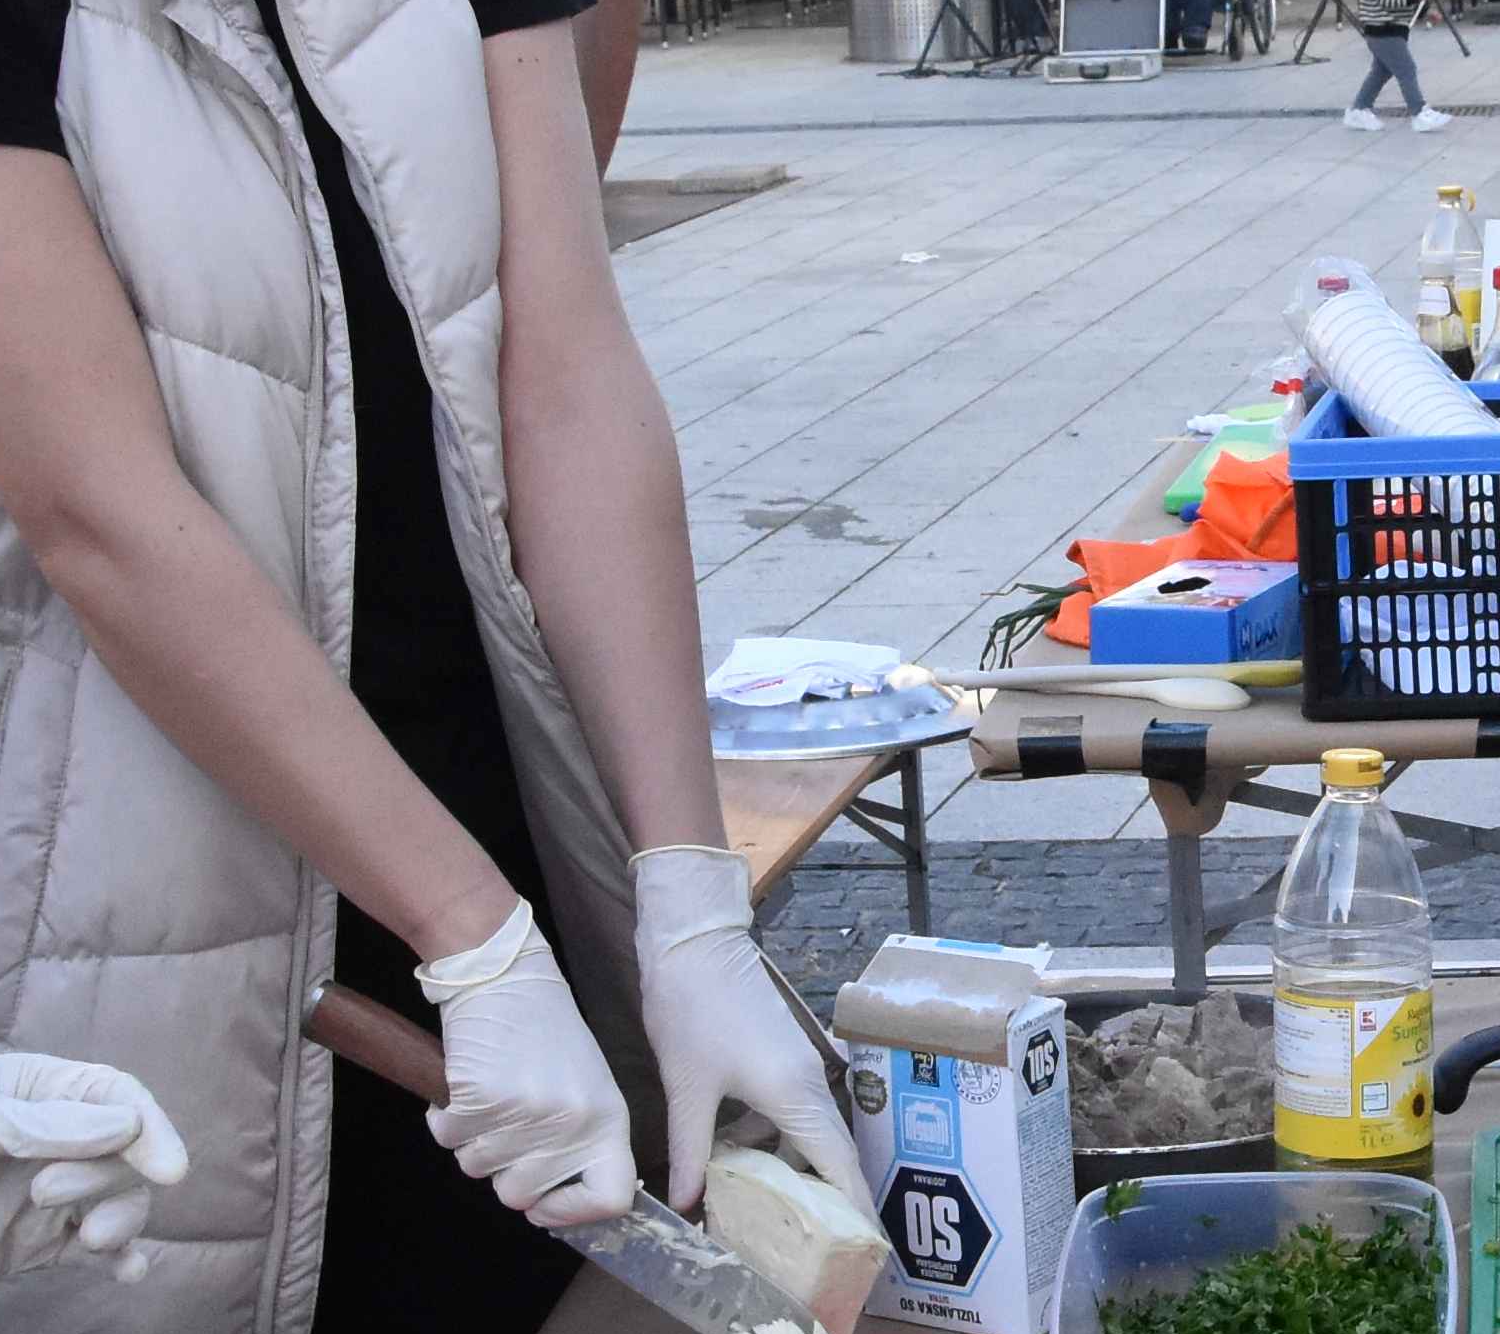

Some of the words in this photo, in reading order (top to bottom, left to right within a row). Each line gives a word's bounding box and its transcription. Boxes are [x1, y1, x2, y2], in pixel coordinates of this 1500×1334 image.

[1027, 1039, 1055, 1083] SOL
[904, 1190, 963, 1262] SO
[900, 1296, 915, 1312] SO
[918, 1302, 983, 1325] TUZLANSKA
